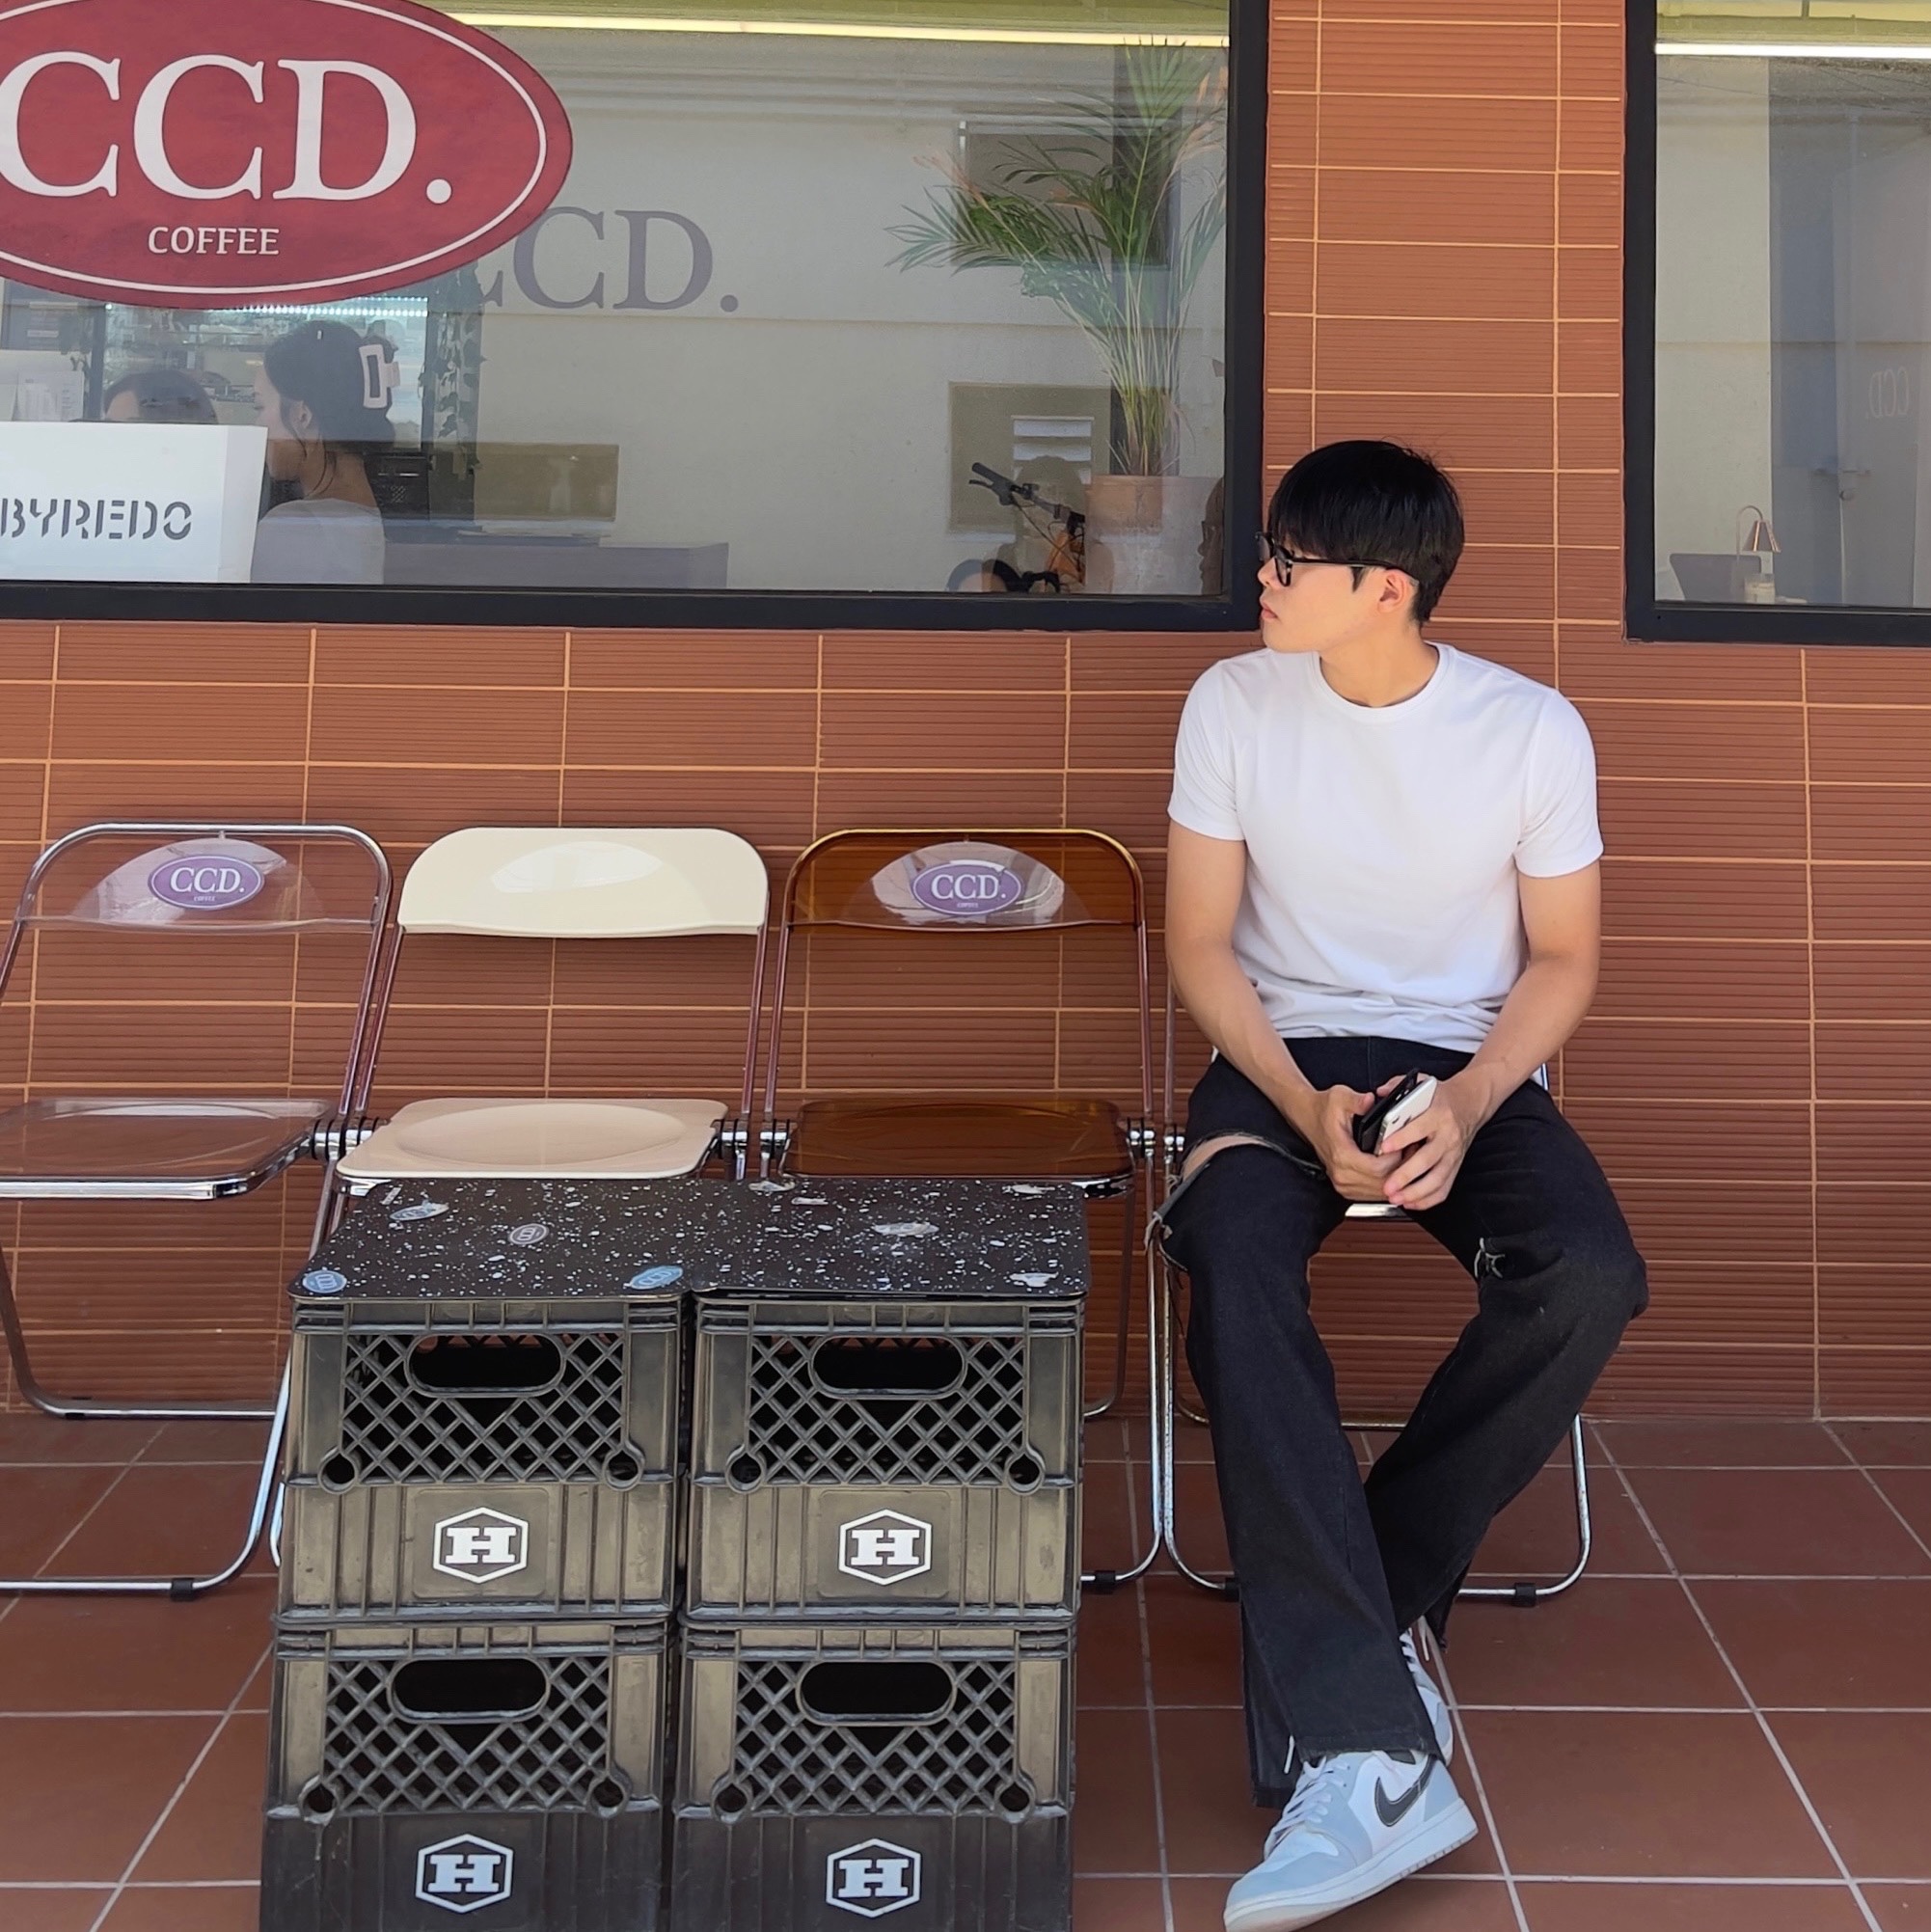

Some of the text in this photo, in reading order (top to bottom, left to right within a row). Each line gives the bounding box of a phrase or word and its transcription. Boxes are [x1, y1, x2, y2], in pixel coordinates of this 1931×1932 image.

[0, 51, 452, 204] CCD.
[148, 226, 280, 256] COFFEE
[0, 498, 192, 540] BYREDO
[170, 867, 245, 893] CCD.
[931, 874, 1006, 900] CCD.
[446, 1527, 516, 1565] H
[850, 1529, 921, 1566] H
[427, 1854, 502, 1893] H
[837, 1858, 910, 1897] H
